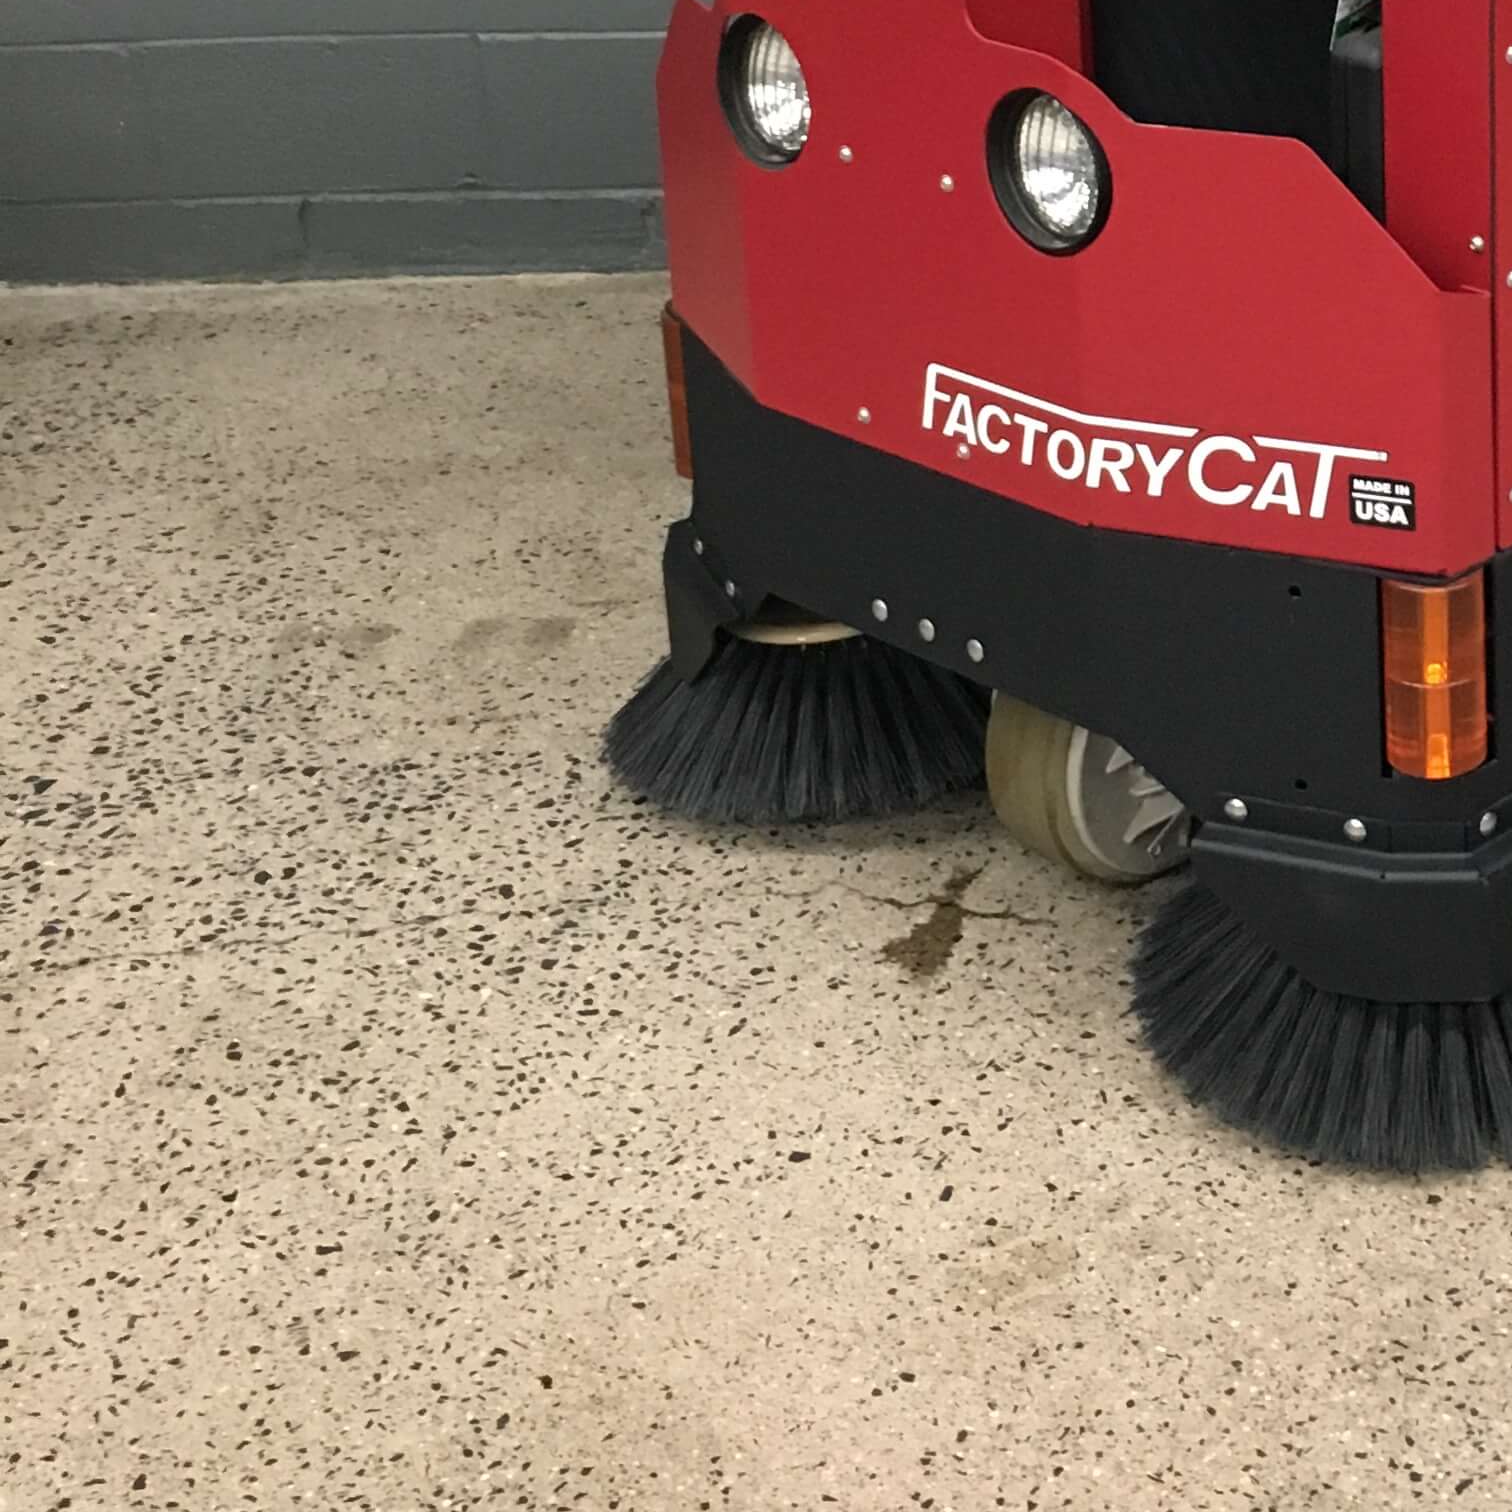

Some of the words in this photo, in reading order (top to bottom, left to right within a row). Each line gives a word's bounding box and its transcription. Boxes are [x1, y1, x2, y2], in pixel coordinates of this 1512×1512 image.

[1353, 478, 1392, 494] MADE
[1395, 484, 1410, 496] IN
[1355, 499, 1409, 525] USA
